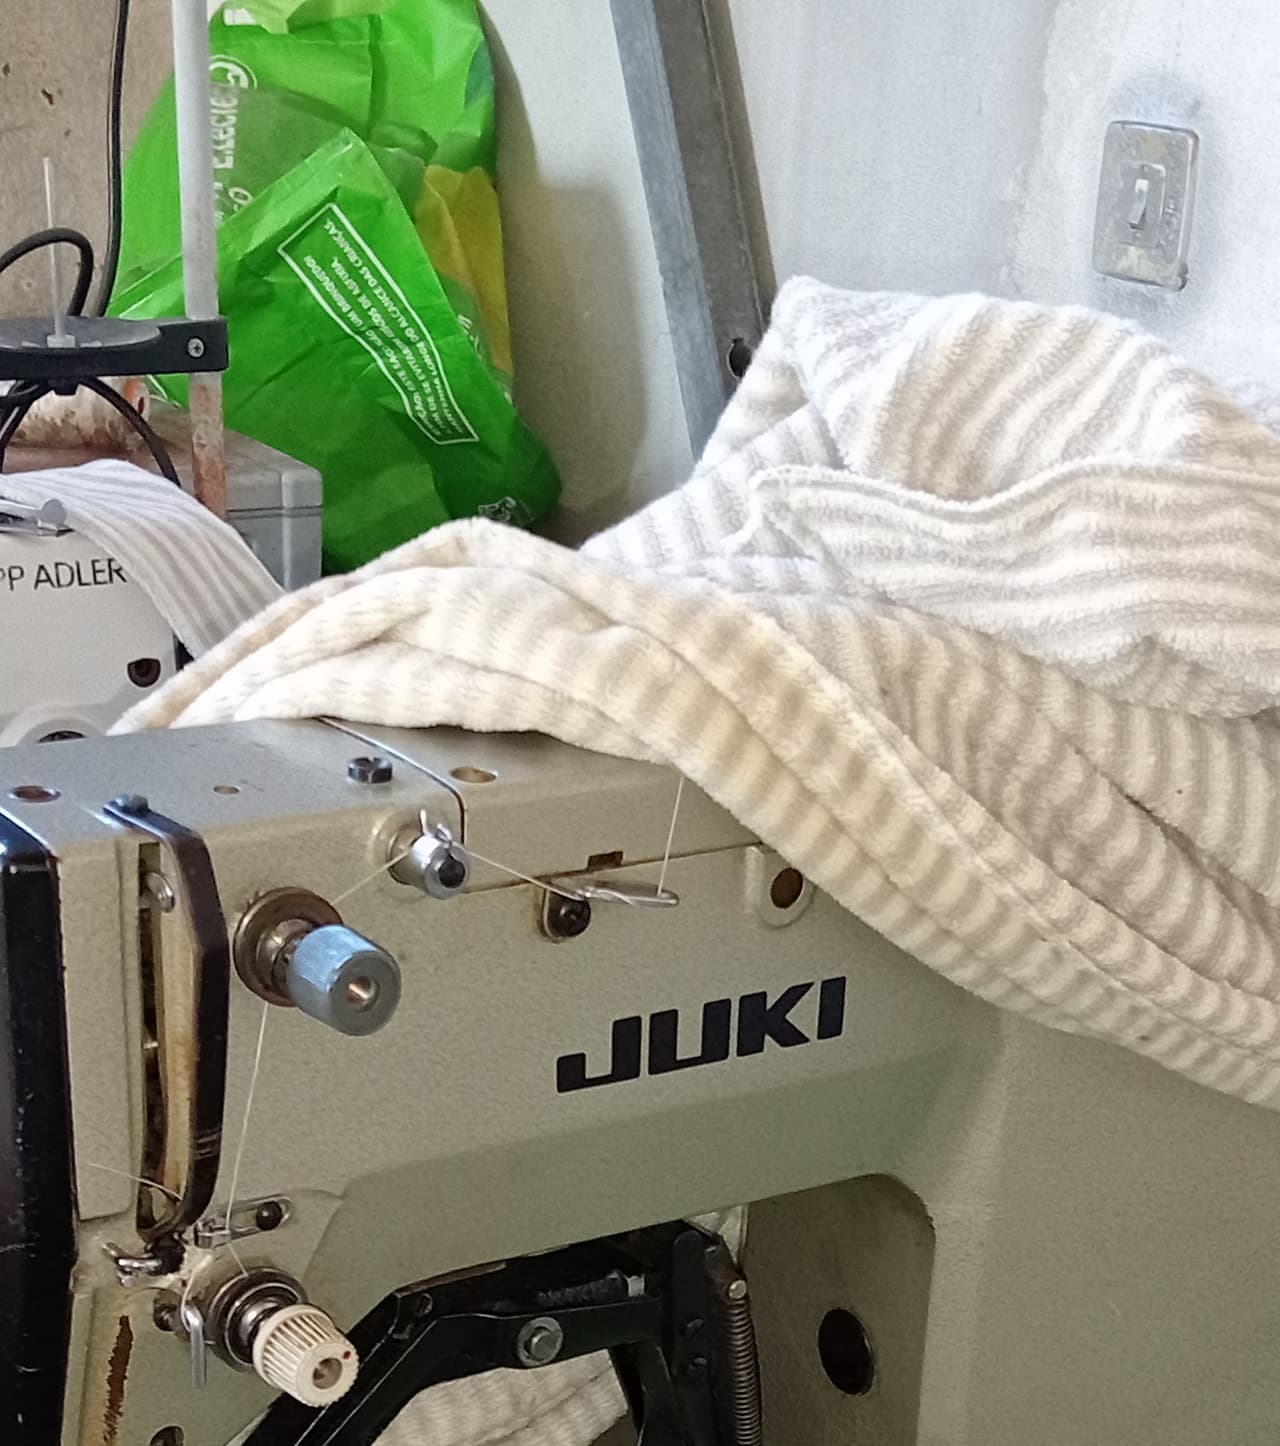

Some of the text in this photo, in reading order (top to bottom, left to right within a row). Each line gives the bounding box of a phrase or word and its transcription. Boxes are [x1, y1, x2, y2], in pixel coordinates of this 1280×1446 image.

[359, 266, 378, 288] DAS
[357, 293, 372, 310] DE
[374, 286, 409, 328] ALCANCE
[347, 310, 363, 328] UM
[34, 557, 128, 591] ADLER
[557, 976, 846, 1093] JUKI
